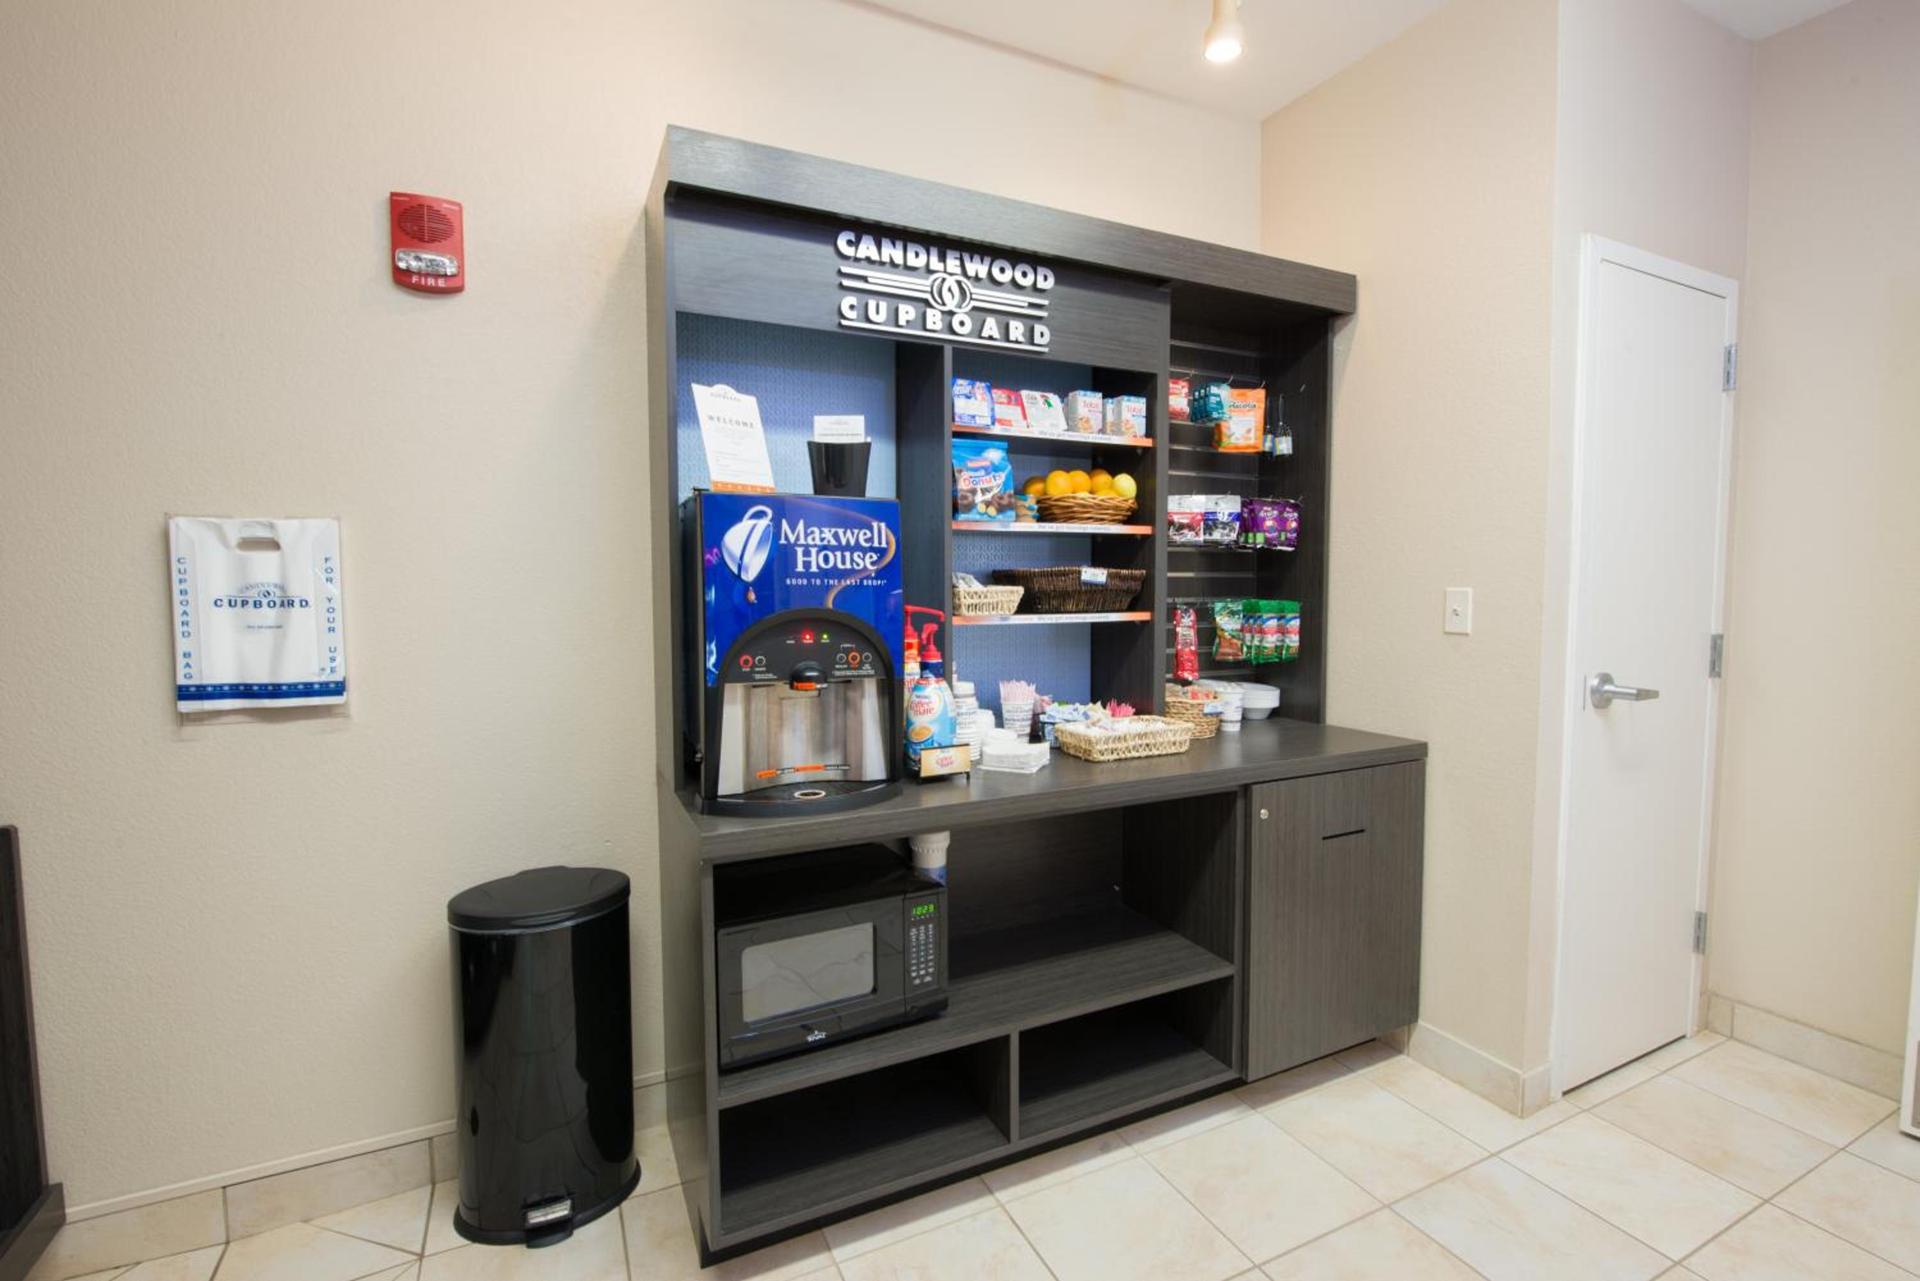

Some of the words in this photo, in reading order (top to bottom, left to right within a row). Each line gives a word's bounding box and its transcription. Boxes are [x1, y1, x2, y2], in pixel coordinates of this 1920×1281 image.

[837, 231, 1055, 290] CANDLEWOOD
[411, 275, 447, 287] FIRE
[840, 296, 1051, 346] CUPBOARD
[708, 414, 754, 429] WELCOME
[779, 518, 888, 548] Maxwell
[324, 557, 334, 584] FOR
[794, 547, 877, 572] House
[786, 577, 808, 586] GOOD
[811, 577, 821, 586] TO
[824, 577, 839, 586] THE
[177, 557, 192, 638] CUPBOARD
[326, 597, 336, 633] YOUR
[183, 651, 193, 680] BAG
[328, 646, 337, 674] USE
